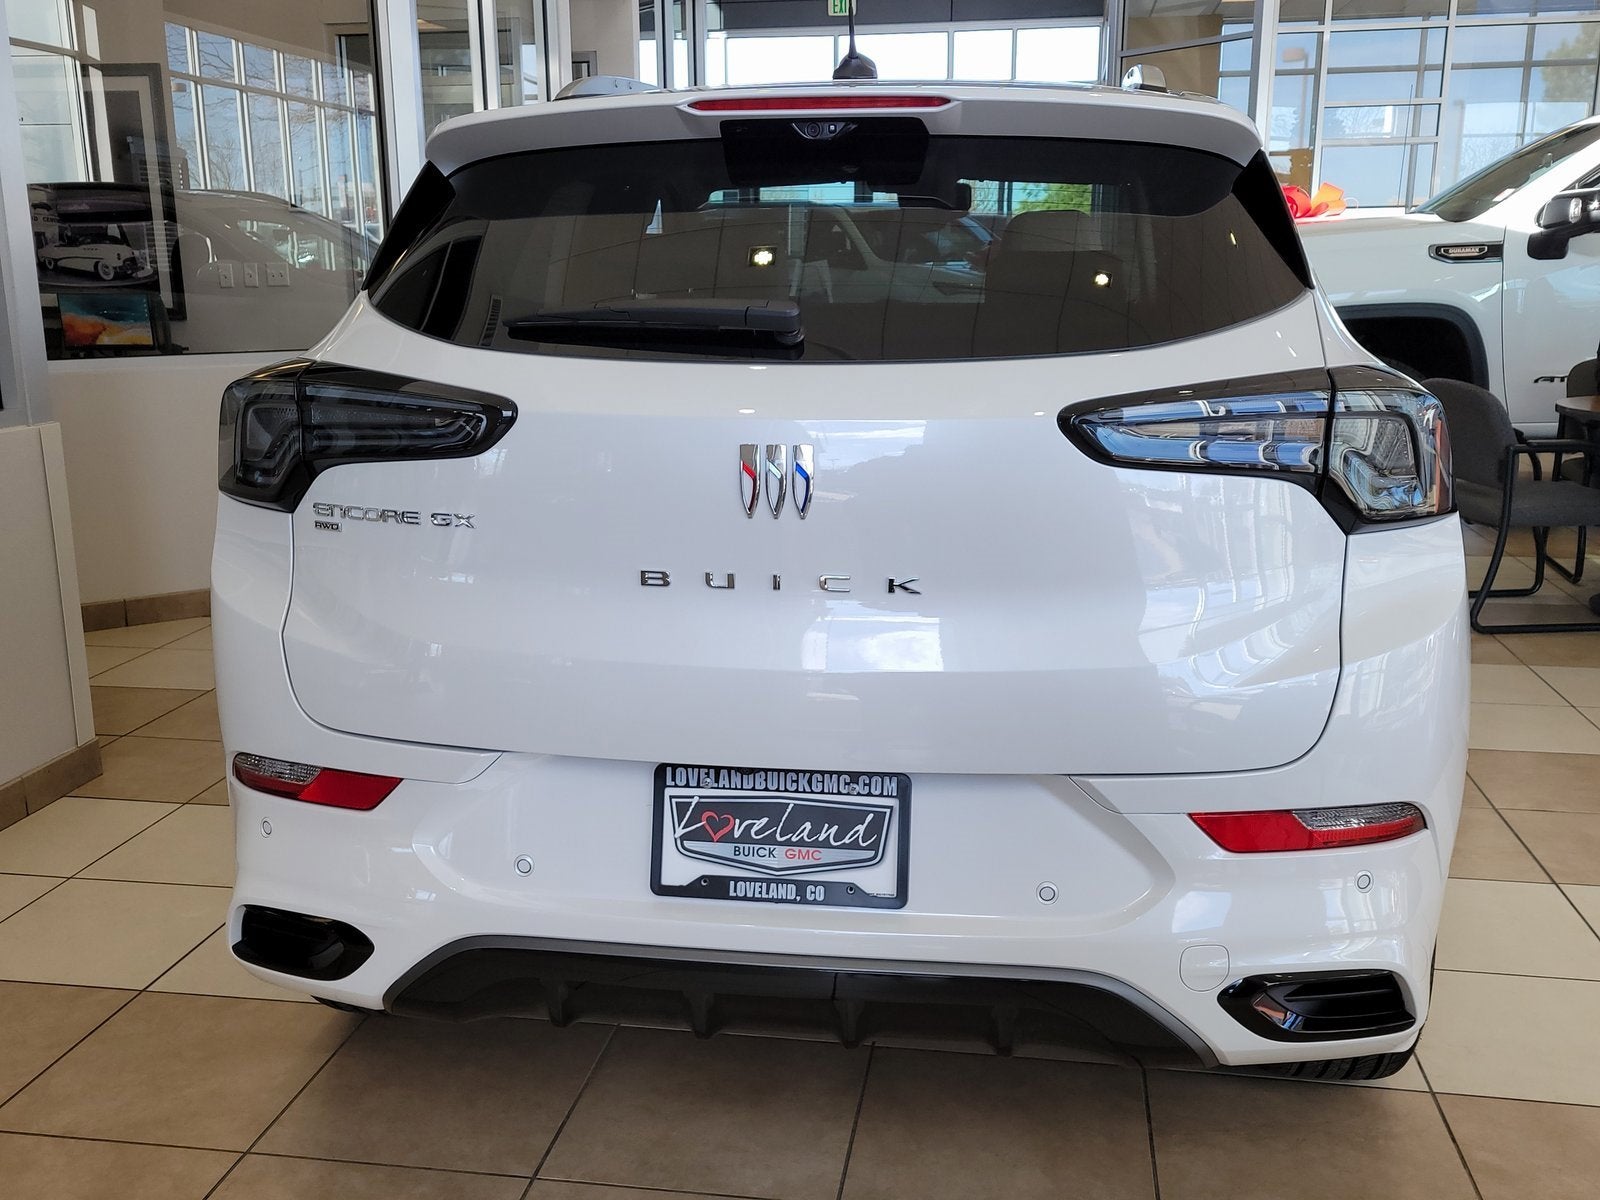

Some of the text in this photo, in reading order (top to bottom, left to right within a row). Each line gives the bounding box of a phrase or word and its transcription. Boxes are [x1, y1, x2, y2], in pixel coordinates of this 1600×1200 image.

[832, 0, 848, 13] EXI
[1533, 375, 1567, 383] AT
[313, 502, 477, 529] ENCORE GX
[640, 570, 922, 595] BUICK
[666, 766, 898, 796] LOVELANDBUICKGMCCOM
[733, 845, 823, 861] BUICK GMC
[729, 880, 825, 902] LOVELAND, CO
